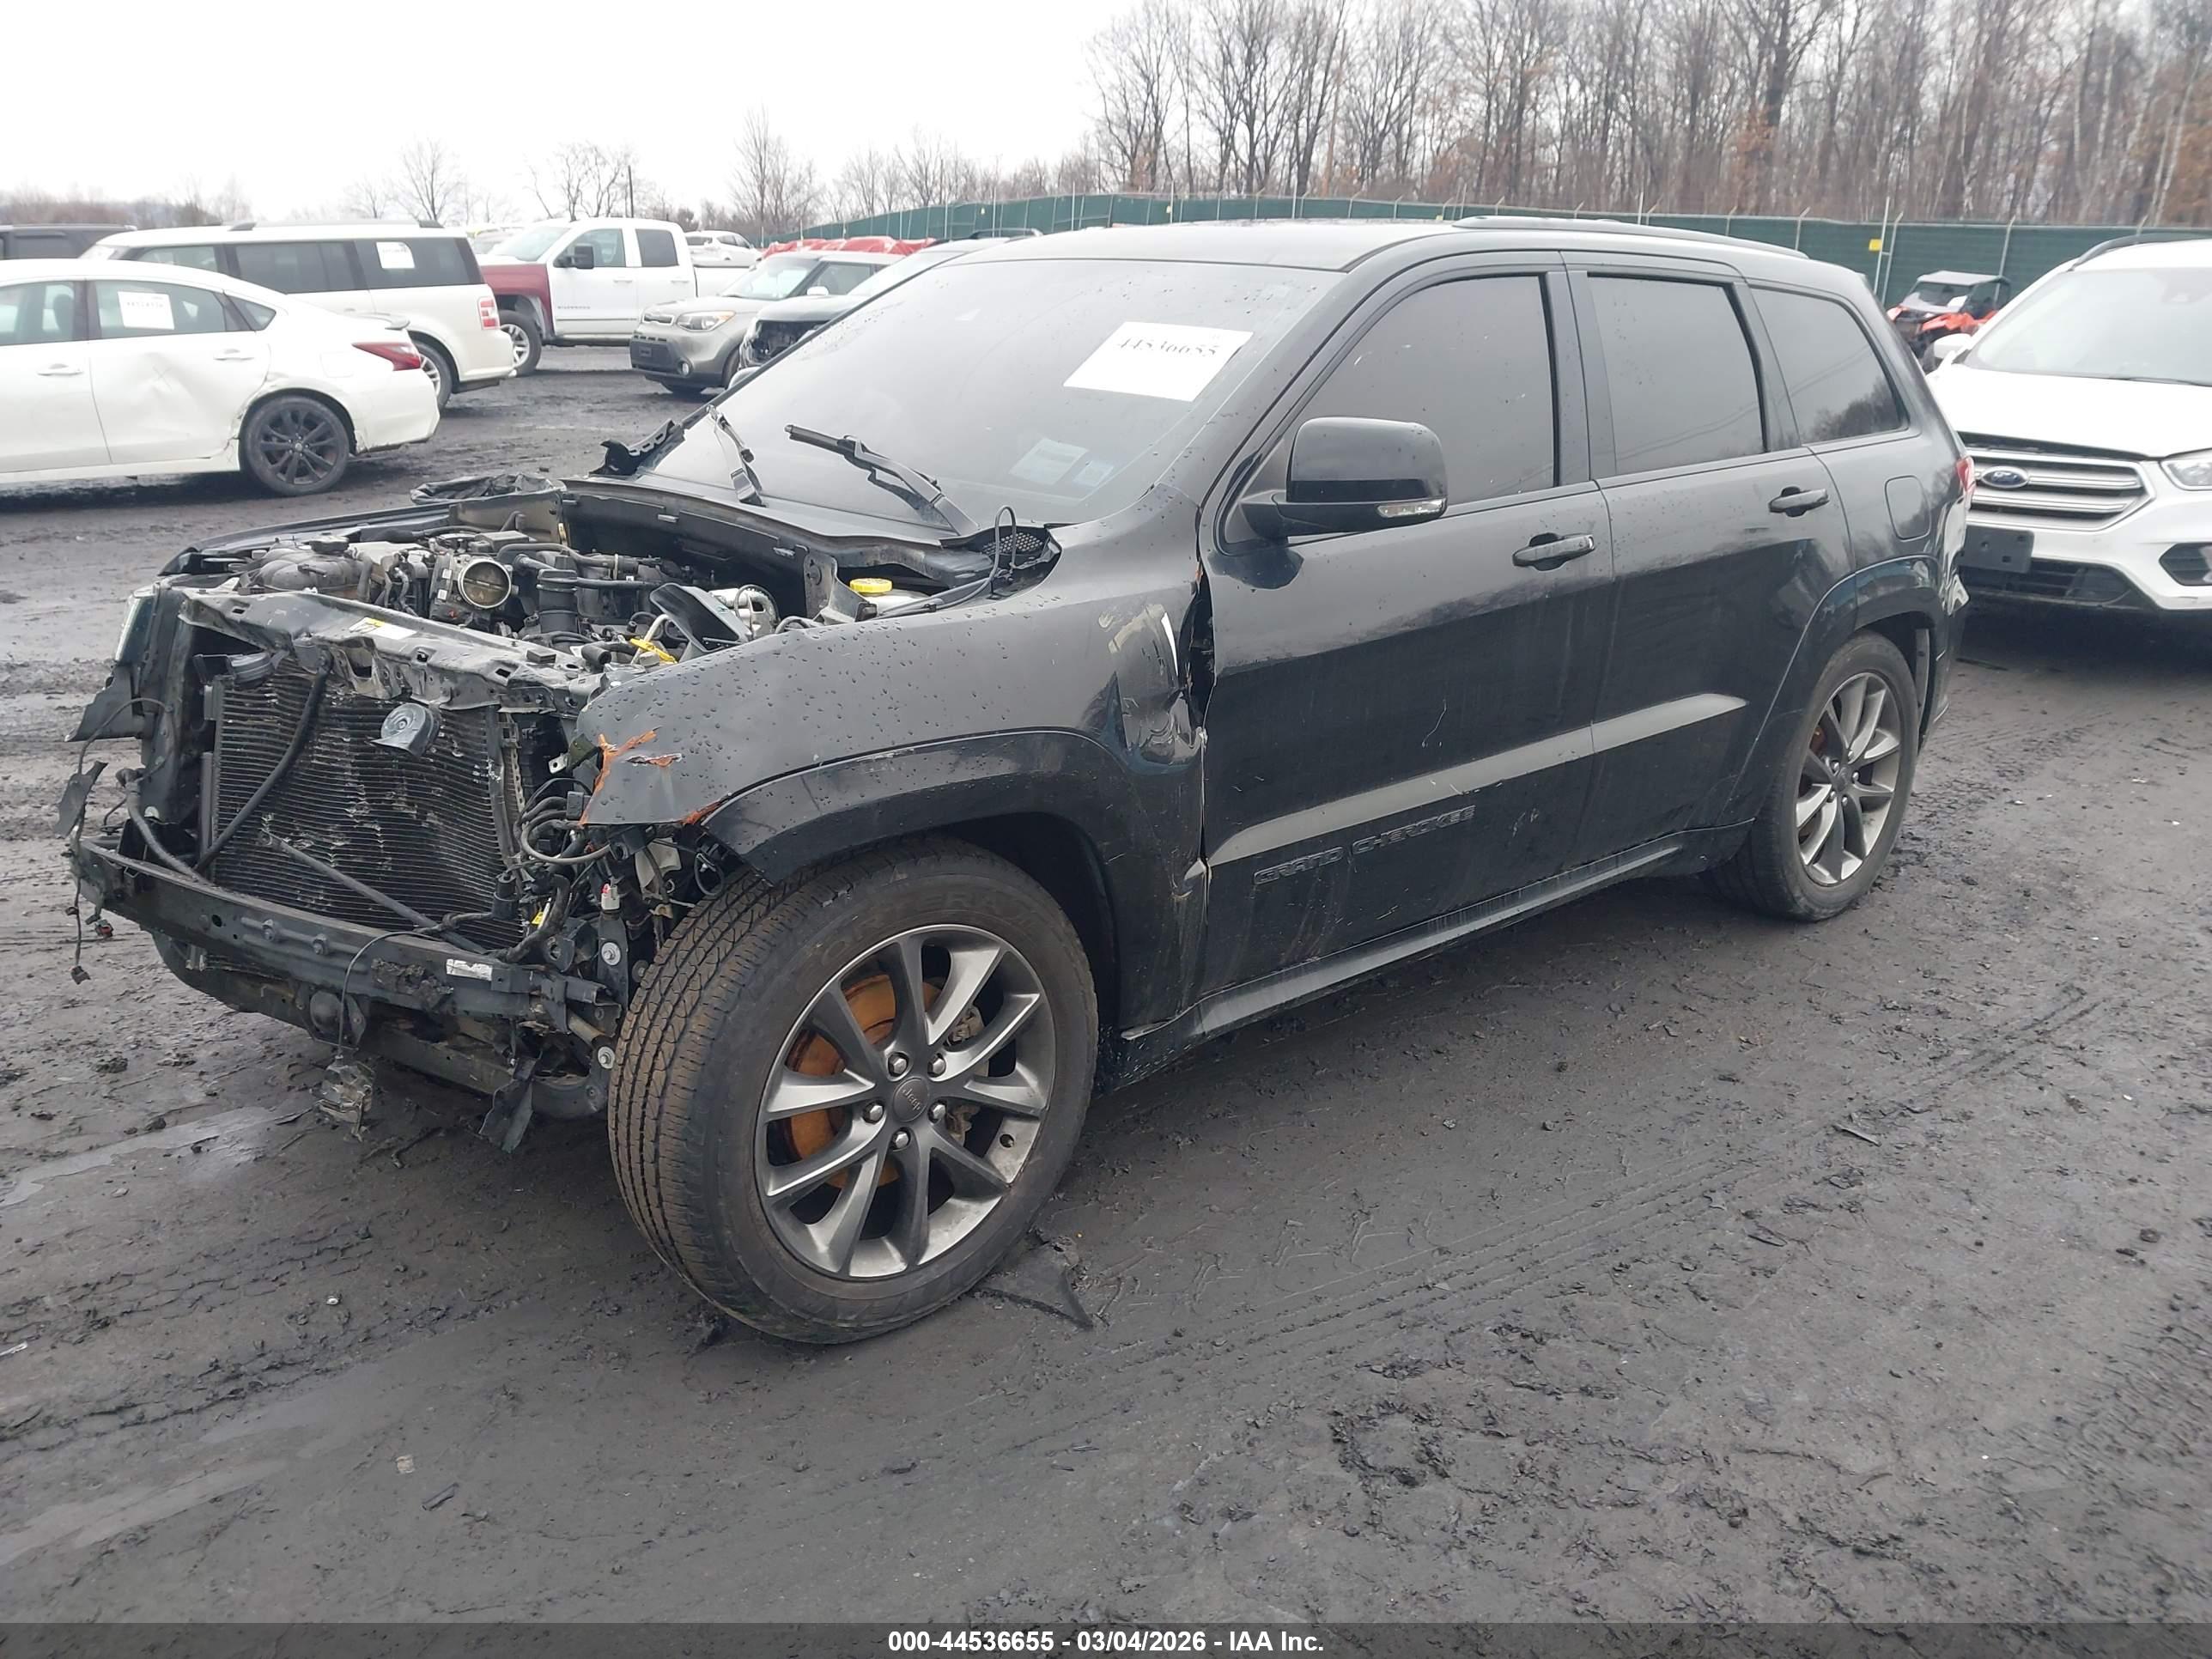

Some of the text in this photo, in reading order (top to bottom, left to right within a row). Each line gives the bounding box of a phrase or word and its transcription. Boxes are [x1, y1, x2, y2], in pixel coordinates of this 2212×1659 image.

[1254, 805, 1476, 884] GRAND CHEROKEE
[902, 1088, 921, 1110] Jeep
